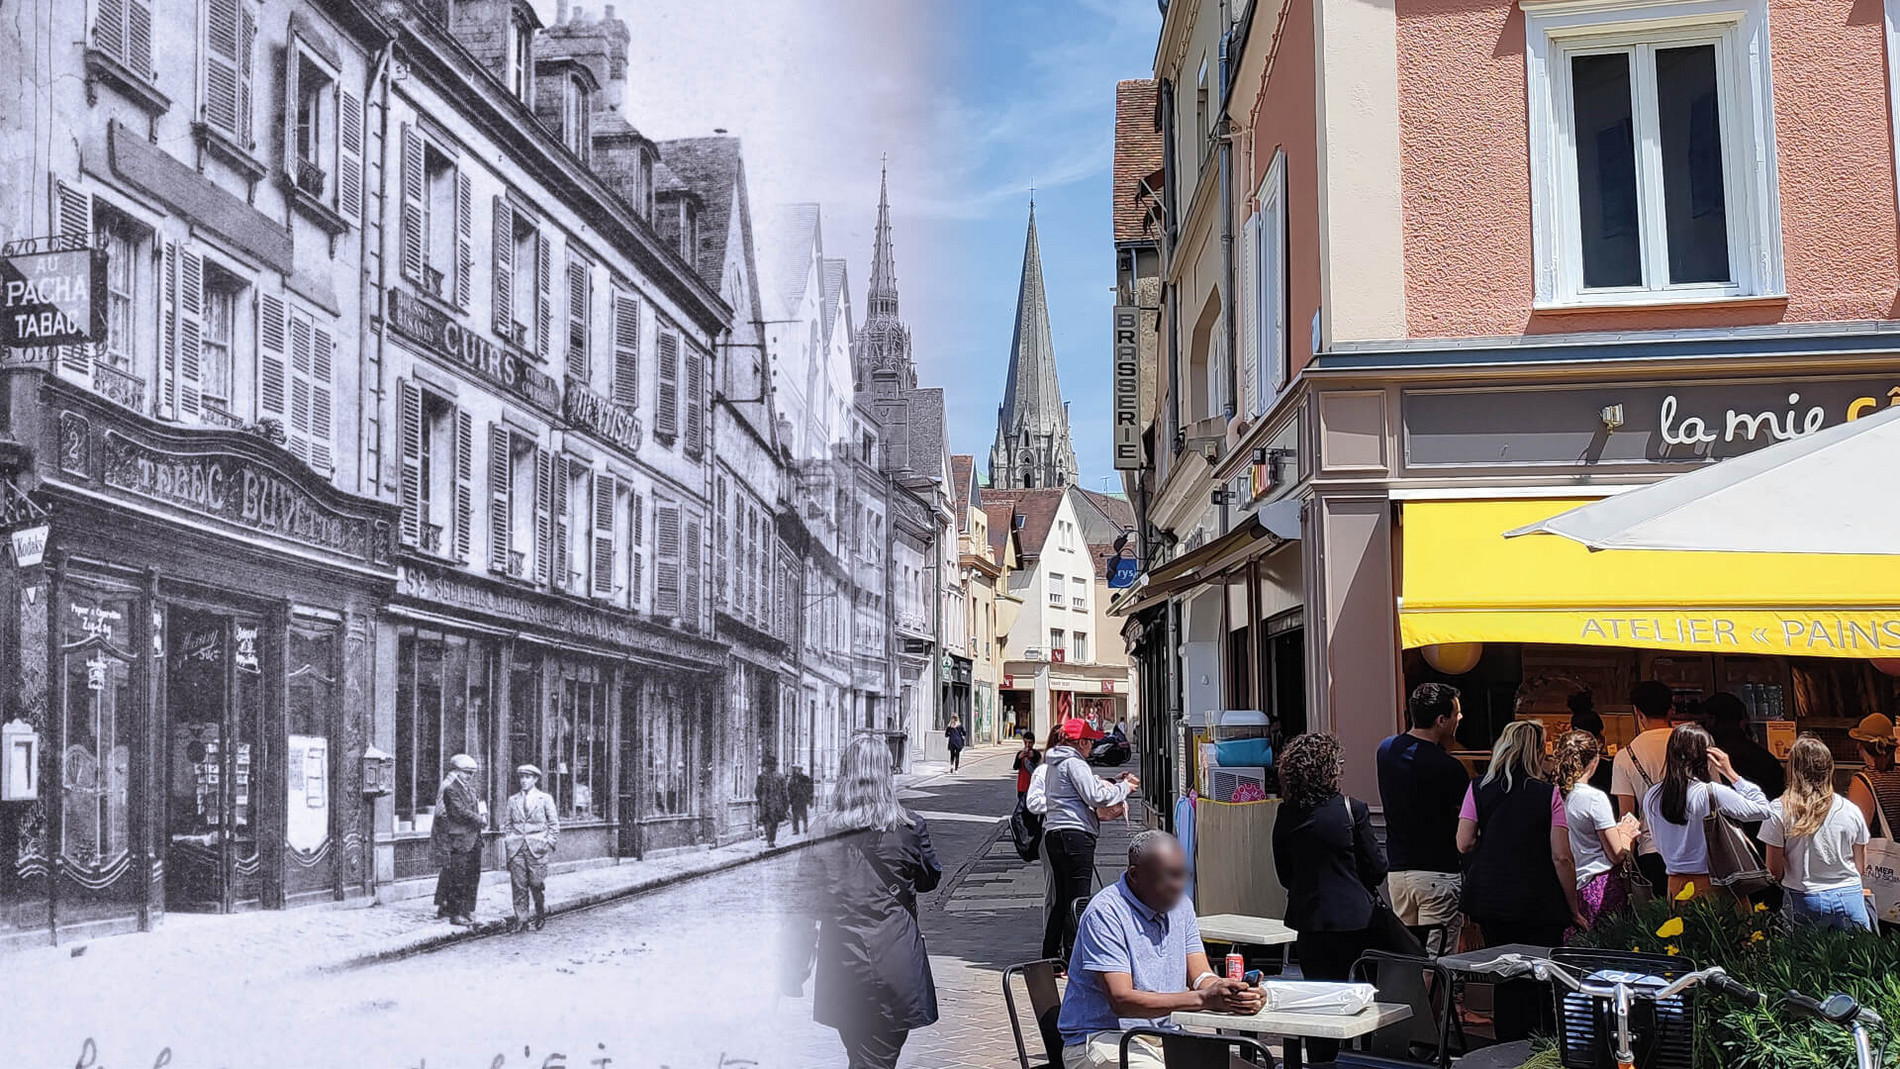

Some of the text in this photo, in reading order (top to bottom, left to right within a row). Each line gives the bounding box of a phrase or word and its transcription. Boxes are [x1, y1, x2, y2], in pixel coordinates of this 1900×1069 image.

[35, 256, 58, 274] AU
[5, 275, 88, 307] PACHA
[14, 310, 80, 339] TABAC
[444, 321, 515, 385] CUIRS
[1117, 313, 1137, 459] BRASSERIE
[578, 388, 641, 449] DENTISTE
[1661, 396, 1717, 444] la
[1724, 393, 1825, 440] mie
[1581, 618, 1739, 645] ATELIER
[1781, 619, 1900, 650] PAINS
